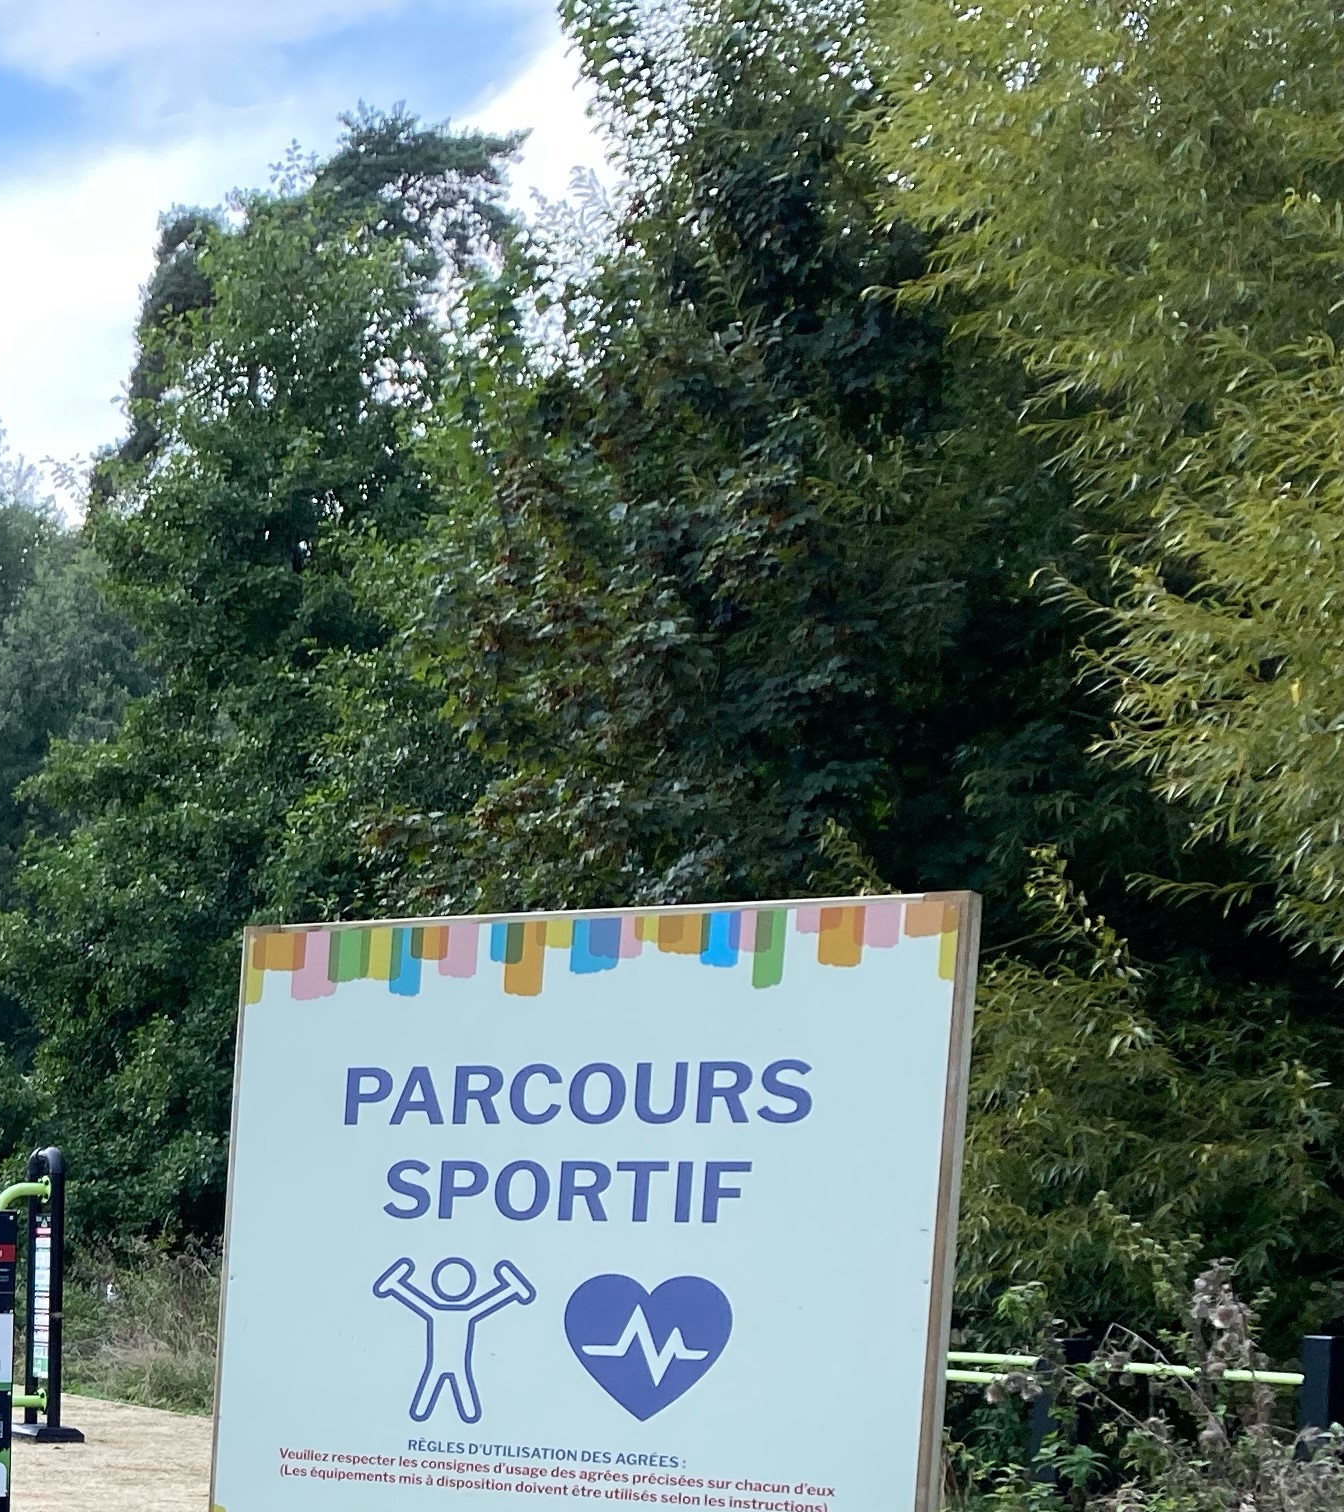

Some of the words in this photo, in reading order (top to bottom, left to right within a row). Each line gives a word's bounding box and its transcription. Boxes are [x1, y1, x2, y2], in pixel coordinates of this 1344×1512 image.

[343, 1059, 813, 1126] PARCOURS
[383, 1159, 753, 1224] SPORTIF
[280, 1447, 329, 1463] Veuillez
[331, 1451, 396, 1468] respecter
[399, 1456, 418, 1468] les
[421, 1458, 490, 1474] consignes
[493, 1460, 548, 1479] d'usage
[551, 1465, 576, 1479] des
[579, 1470, 629, 1484] agrées
[632, 1473, 704, 1489] précisées
[707, 1479, 732, 1490] sur
[735, 1478, 790, 1494] chacun
[794, 1483, 836, 1498] d'eux
[408, 1437, 465, 1454] RÈGLES
[468, 1443, 578, 1462] D'UTILISATION
[581, 1451, 612, 1465] DES
[616, 1452, 679, 1468] AGRÉES
[280, 1464, 308, 1477] (Les
[310, 1466, 396, 1484] équipements
[399, 1474, 422, 1486] mis
[425, 1474, 434, 1487] à
[436, 1476, 512, 1492] disposition
[515, 1481, 569, 1496] doivent
[572, 1484, 602, 1499] être
[605, 1487, 657, 1503] utilisés
[660, 1492, 701, 1506] selon
[704, 1494, 726, 1507] les
